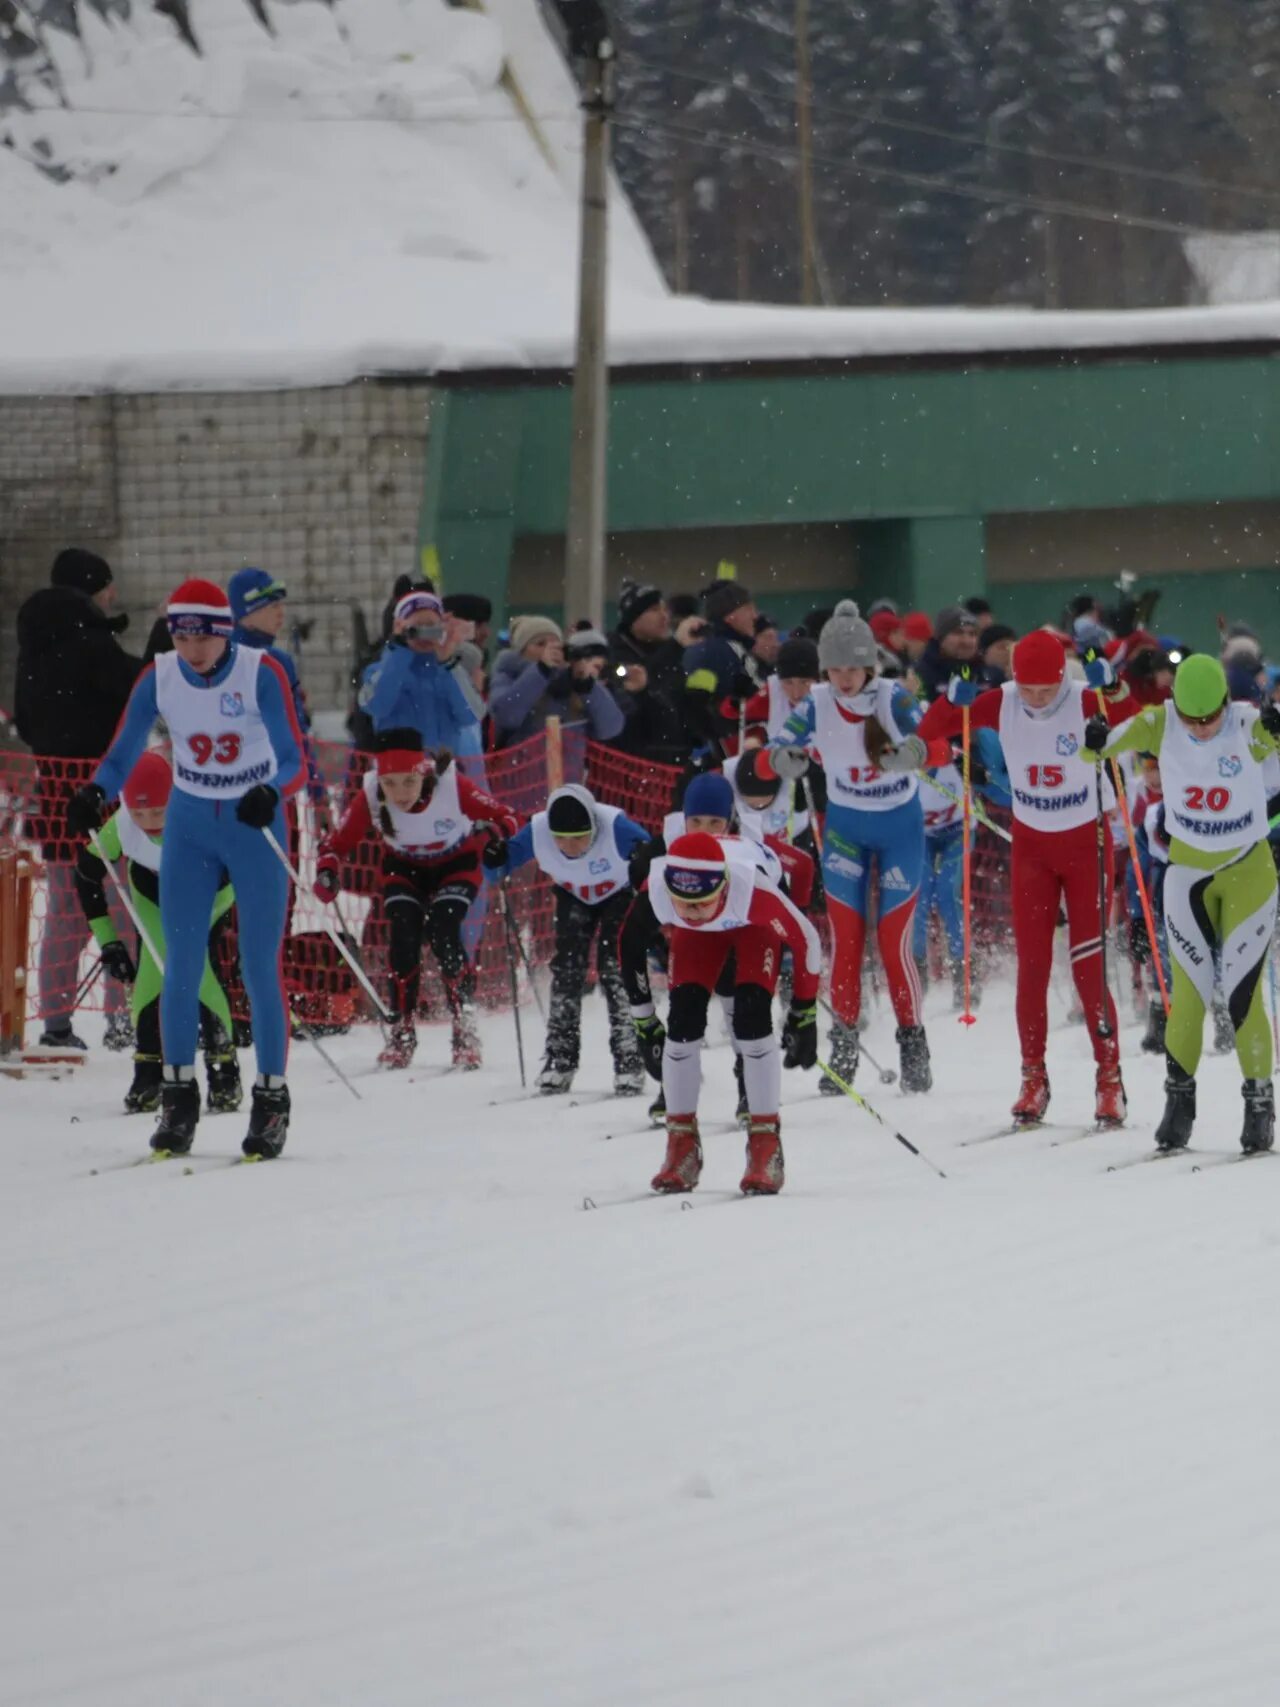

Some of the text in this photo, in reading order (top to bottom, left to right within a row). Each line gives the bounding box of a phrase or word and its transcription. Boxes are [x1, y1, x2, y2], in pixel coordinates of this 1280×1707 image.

[188, 732, 242, 766] 93
[1026, 764, 1065, 789] 15
[1184, 786, 1231, 812] 20
